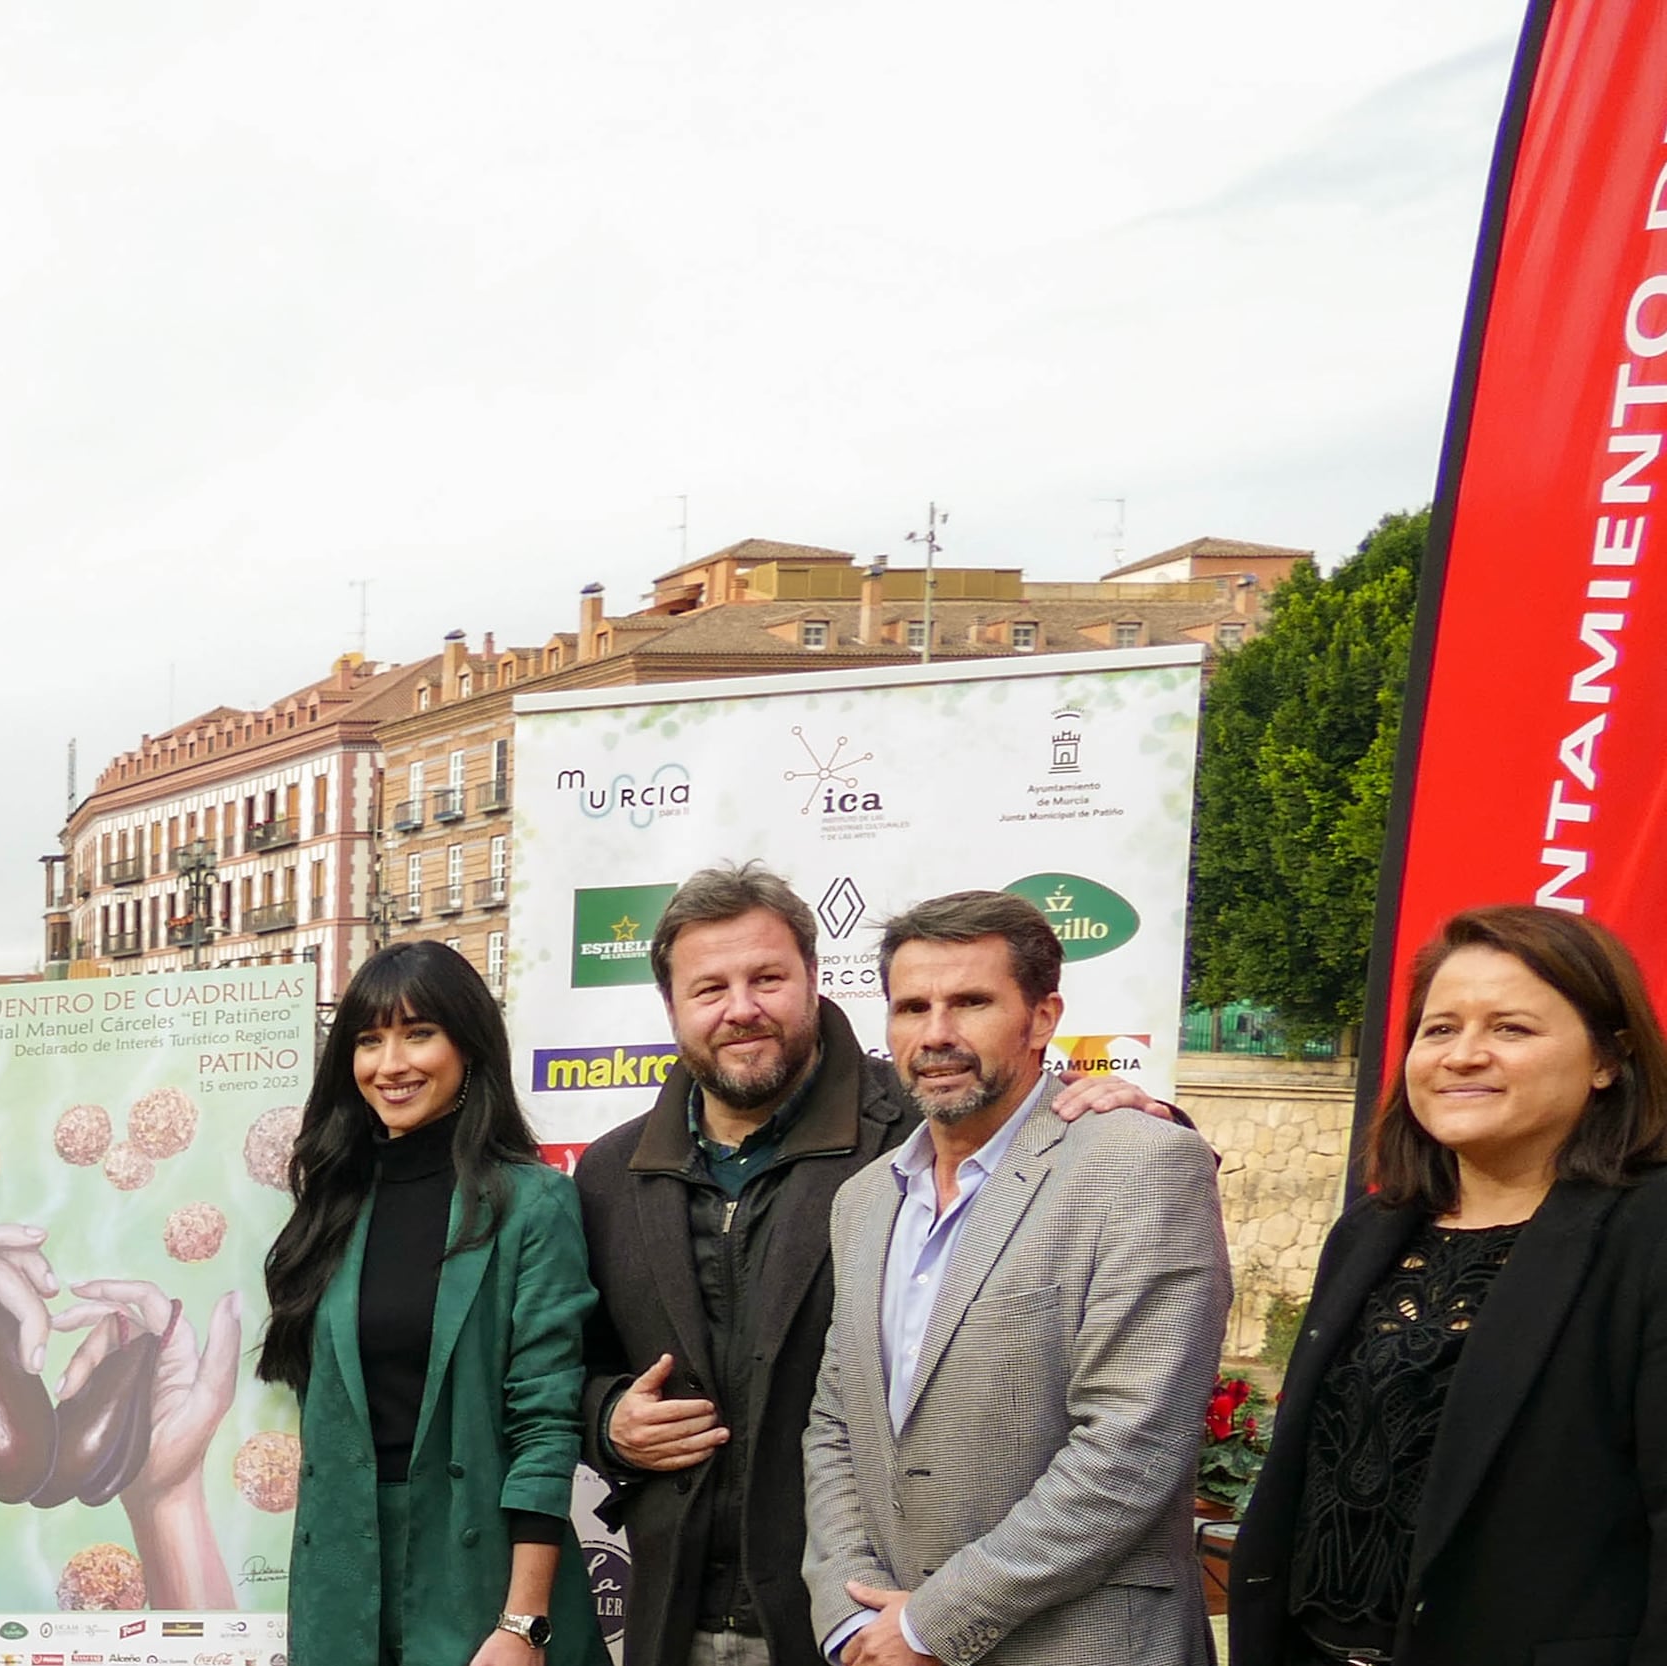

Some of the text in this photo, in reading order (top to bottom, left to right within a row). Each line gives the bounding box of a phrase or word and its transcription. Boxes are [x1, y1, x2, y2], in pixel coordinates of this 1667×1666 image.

[1535, 274, 1667, 916] NTAMIENTO
[1027, 782, 1102, 795] Ayuntamiento
[823, 788, 883, 813] ica
[1037, 796, 1089, 807] de Murcia
[999, 807, 1124, 822] Junta Municipal de Patiño
[1053, 917, 1109, 940] zillo
[843, 955, 851, 964] Y
[822, 969, 876, 986] RCO
[104, 990, 135, 1011] DE
[146, 978, 305, 1008] CUADRILLAS
[26, 1018, 94, 1038] Manuel
[100, 1014, 174, 1032] Cárceles
[15, 1026, 300, 1057] Declarado de Interés Turístico Regional
[199, 1046, 299, 1074] PATIÑO
[1040, 1058, 1142, 1073] CAMURCIA
[199, 1076, 299, 1093] 15 enero 2023
[596, 1596, 623, 1616] LER
